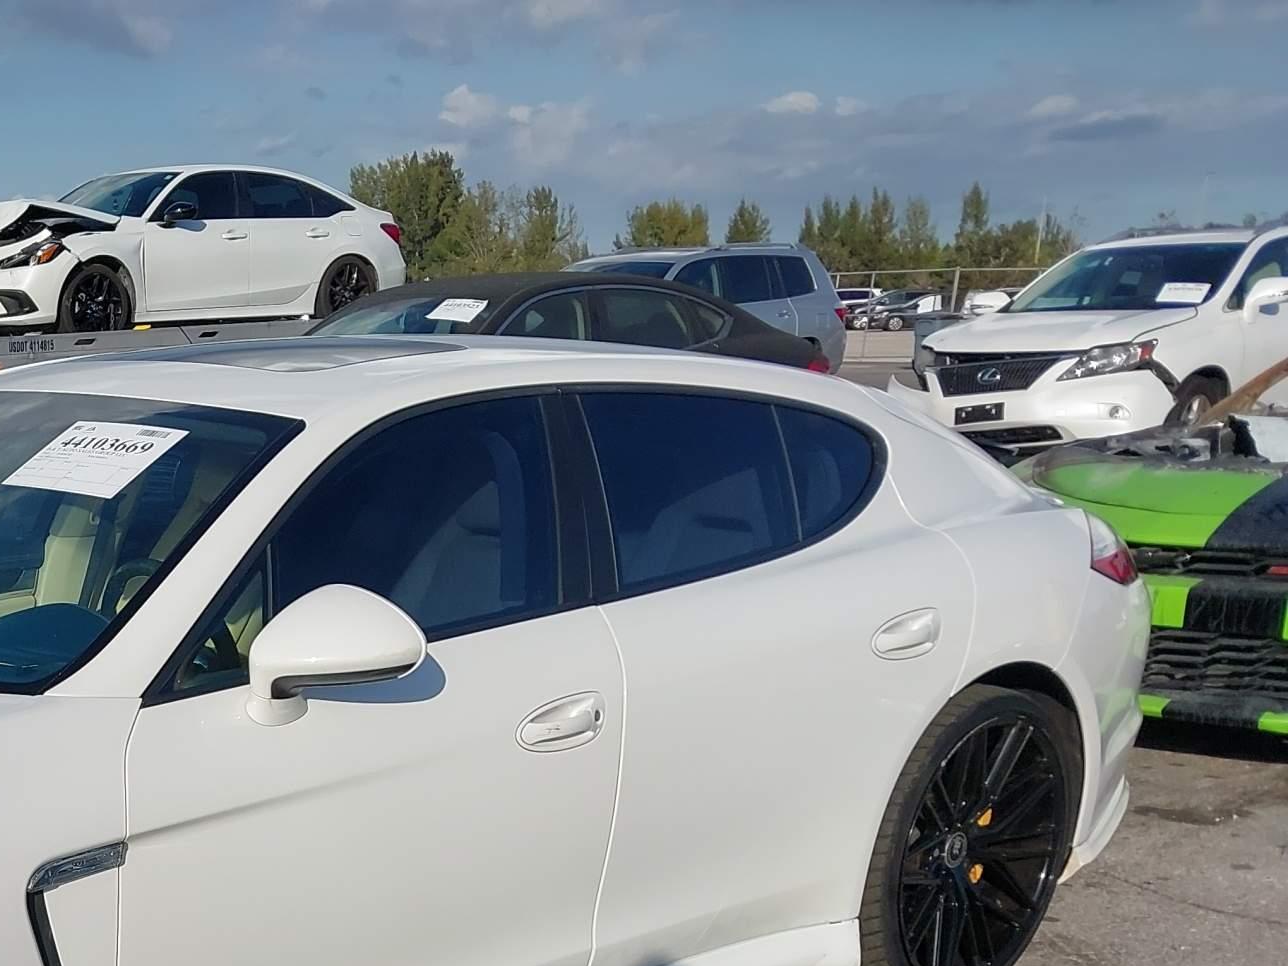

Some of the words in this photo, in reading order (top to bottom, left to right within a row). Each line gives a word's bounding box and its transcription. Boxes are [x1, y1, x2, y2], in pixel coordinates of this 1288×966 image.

[8, 341, 28, 353] USDOT
[29, 340, 55, 352] 4114815
[61, 435, 155, 455] 44103669
